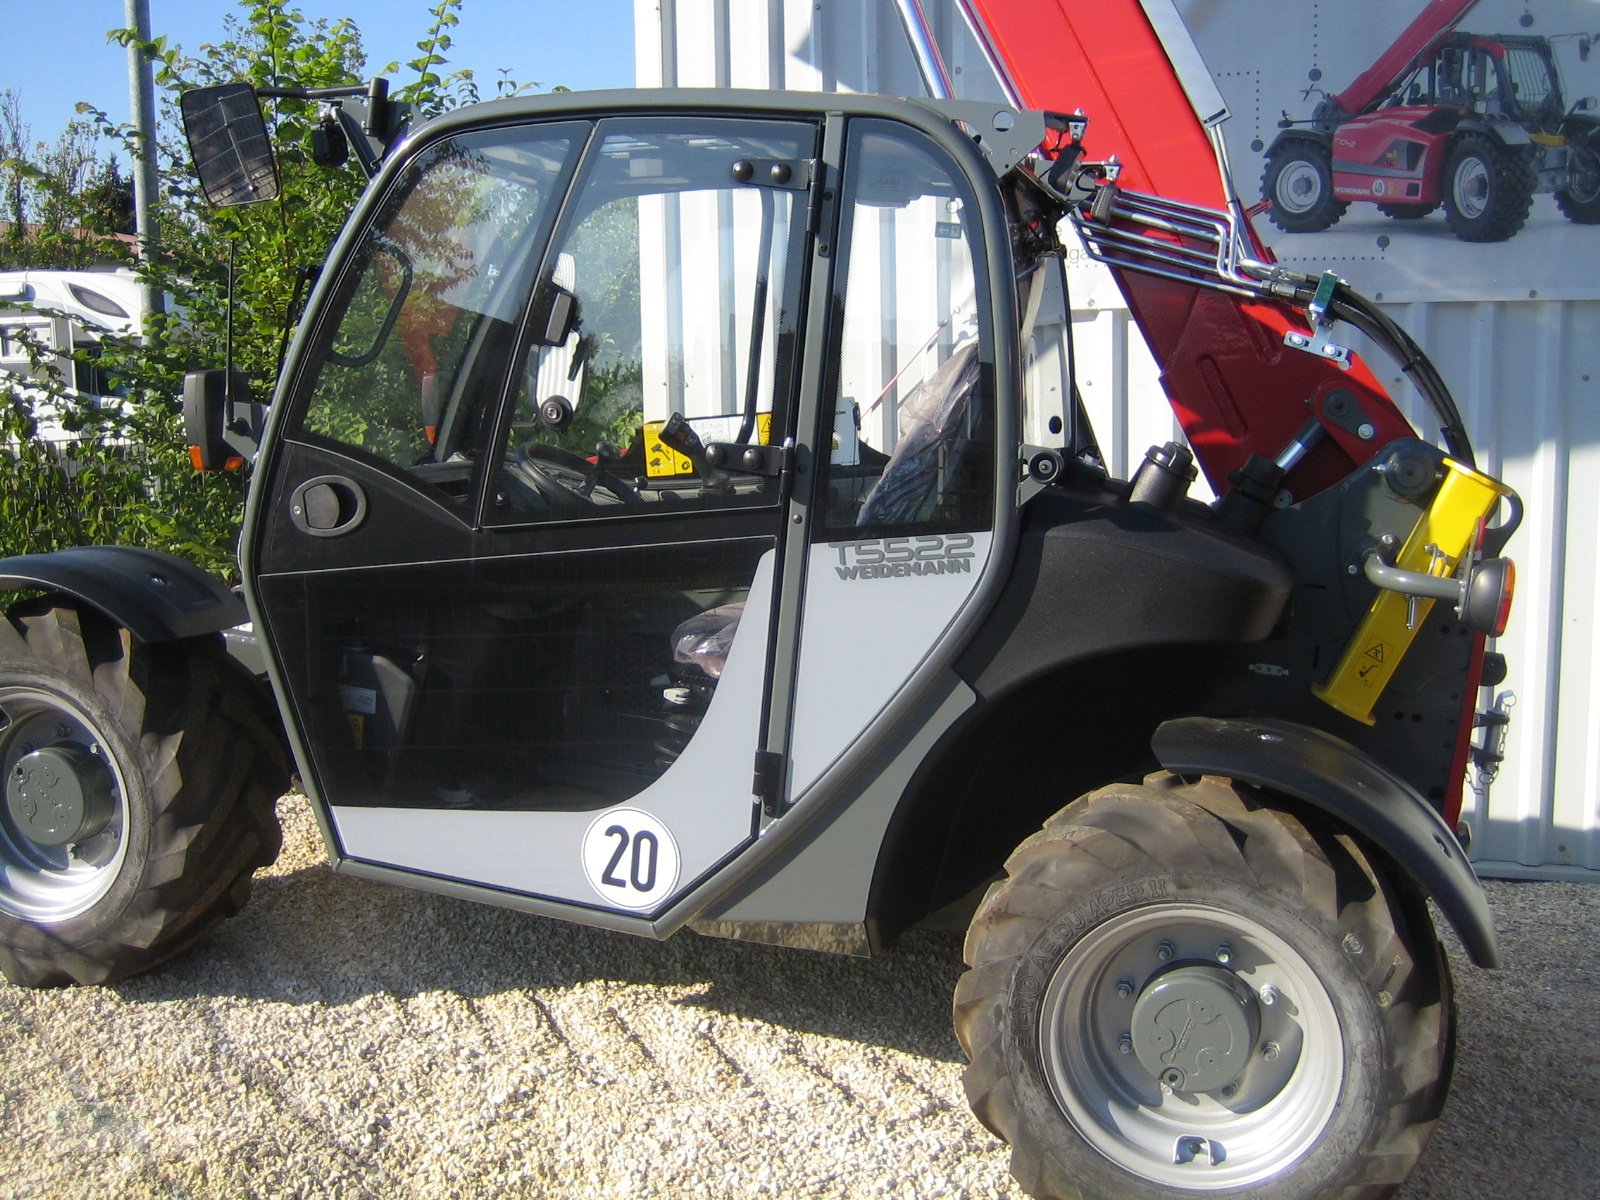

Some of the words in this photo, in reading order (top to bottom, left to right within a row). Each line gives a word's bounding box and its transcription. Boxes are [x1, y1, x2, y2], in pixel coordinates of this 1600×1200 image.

[828, 533, 975, 565] T5522
[834, 558, 971, 581] WEIDEMANN
[601, 824, 659, 893] 20
[1052, 885, 1147, 940] DUMPER
